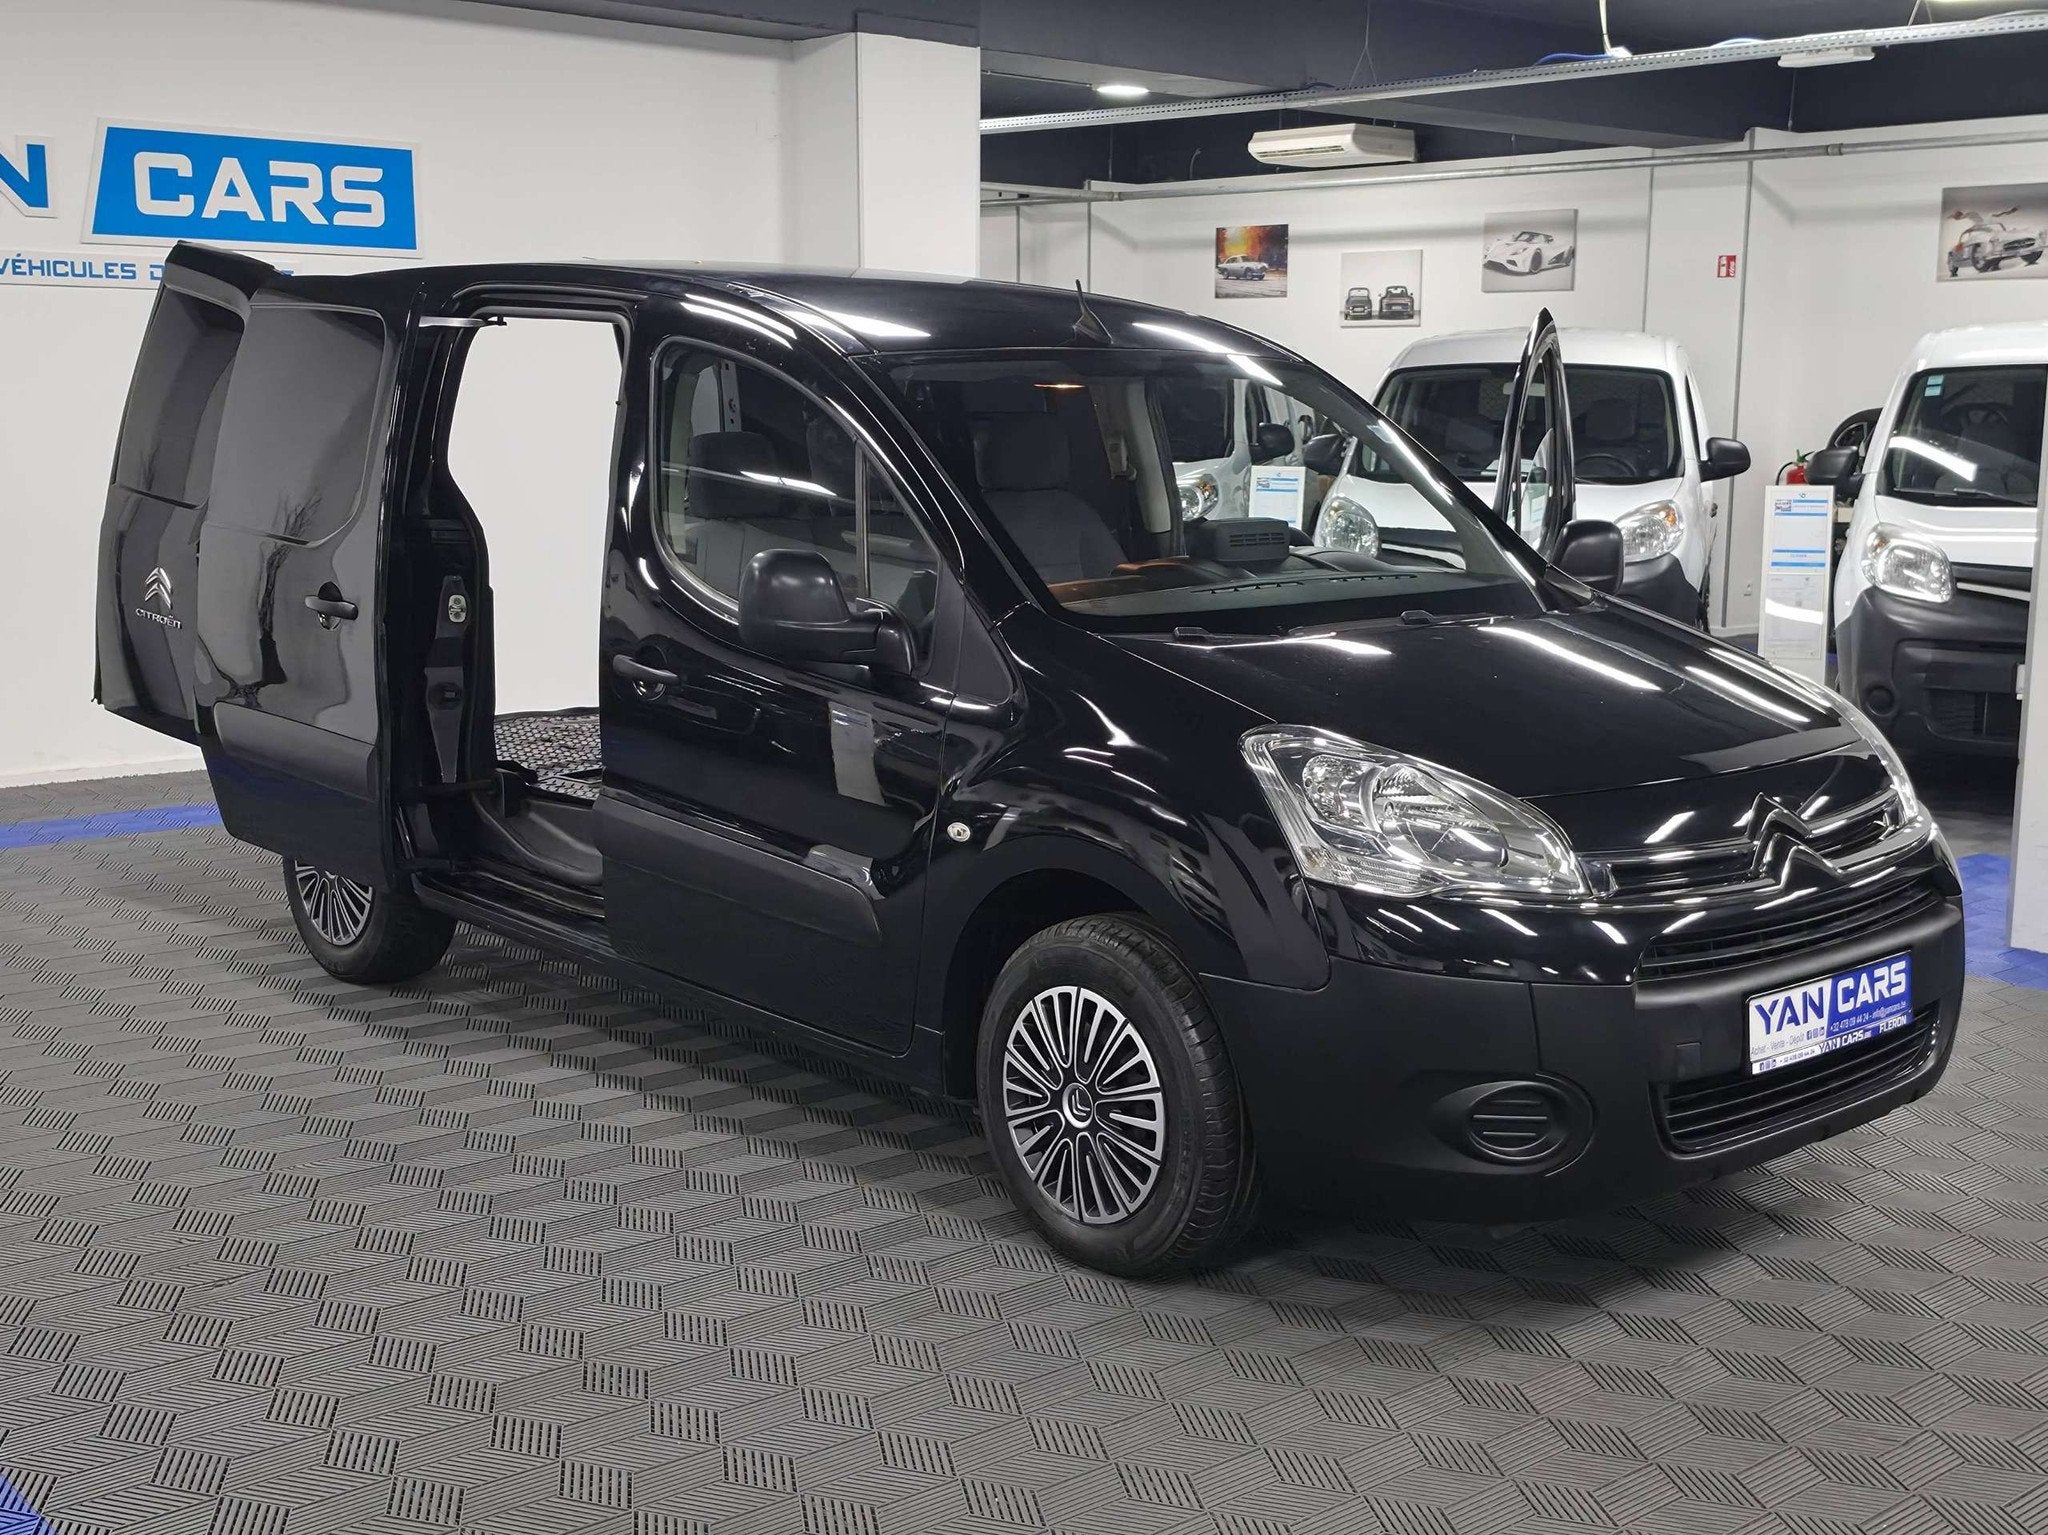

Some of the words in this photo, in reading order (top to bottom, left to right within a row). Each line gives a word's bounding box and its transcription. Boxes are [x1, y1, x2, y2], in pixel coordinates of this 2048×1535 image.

[133, 151, 385, 228] CARS
[0, 253, 137, 281] VÉHICULES
[1755, 987, 1824, 1035] YAN
[1837, 961, 1906, 1013] CARS
[1841, 1029, 1864, 1046] CARS
